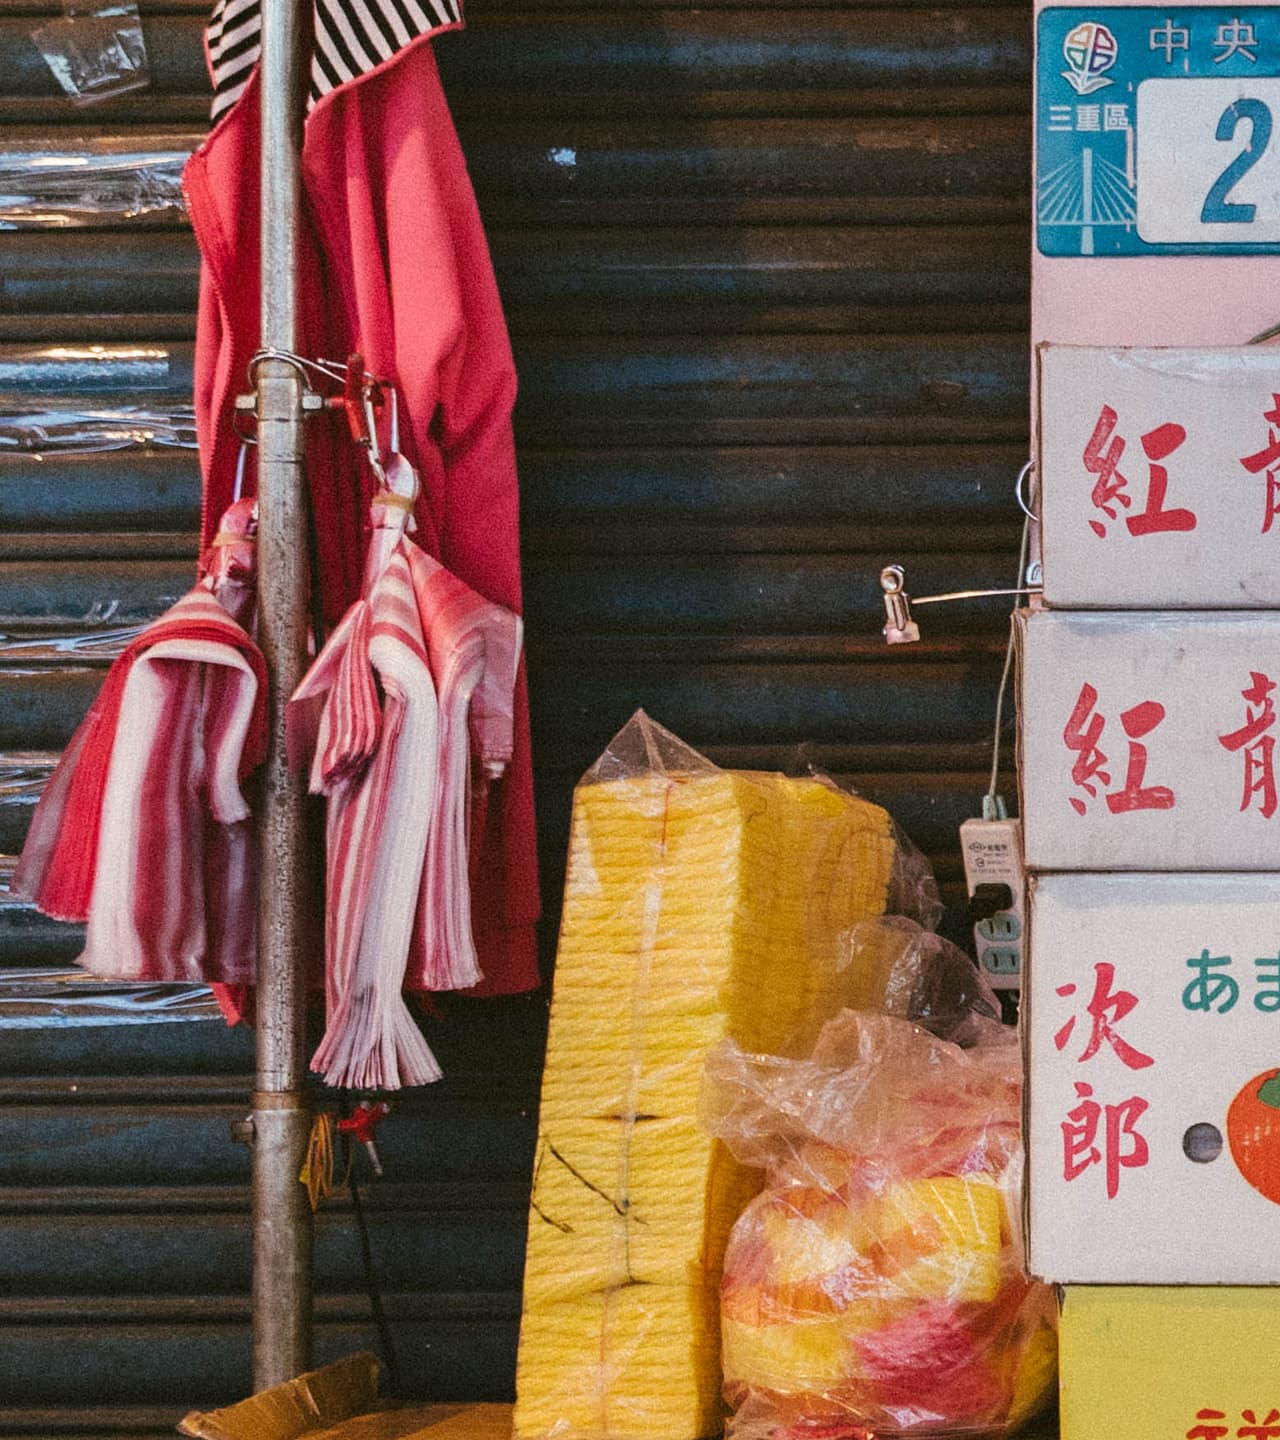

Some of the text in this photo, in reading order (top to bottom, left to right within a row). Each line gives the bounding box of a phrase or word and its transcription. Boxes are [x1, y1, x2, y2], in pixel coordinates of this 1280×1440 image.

[1047, 102, 1130, 133] 三重區
[1054, 962, 1156, 1201] 次郎
